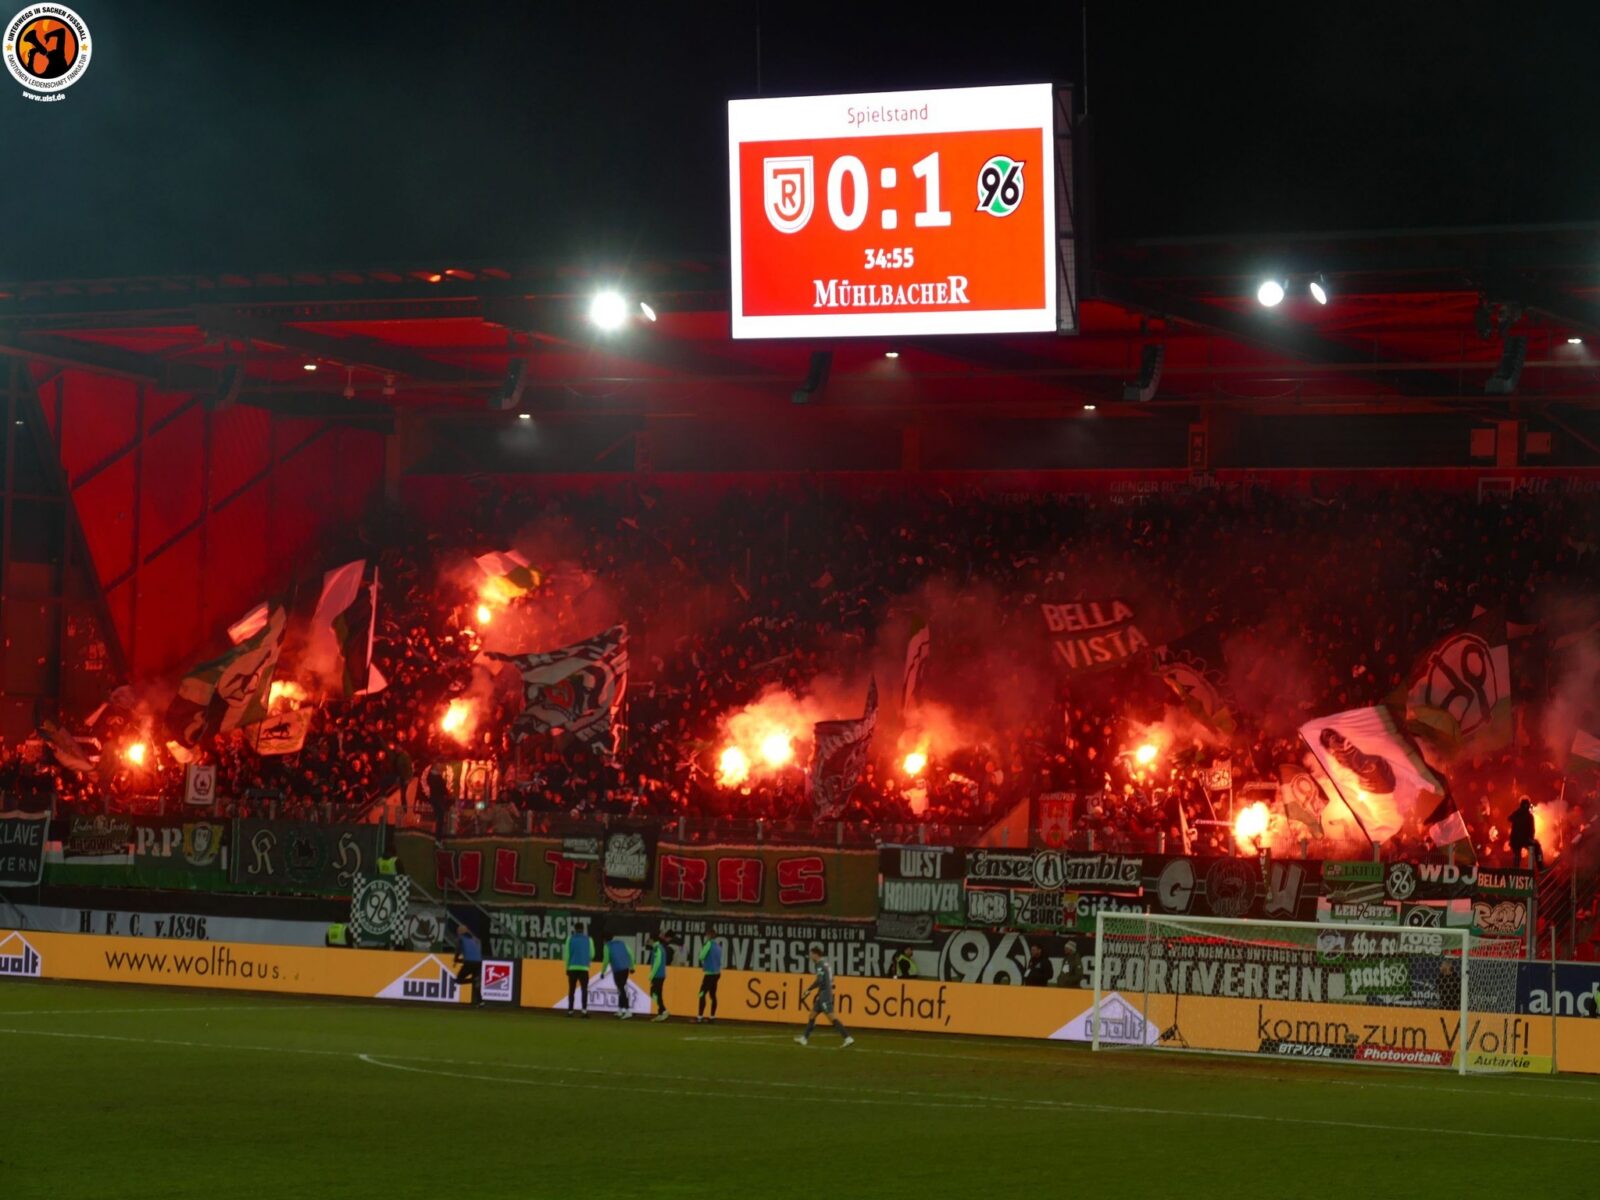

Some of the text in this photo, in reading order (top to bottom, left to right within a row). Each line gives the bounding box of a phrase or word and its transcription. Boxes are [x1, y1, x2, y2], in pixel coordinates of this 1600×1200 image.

[848, 104, 928, 127] Spielstand
[981, 166, 1020, 207] 96
[864, 247, 914, 269] 34:55
[813, 276, 970, 307] MÜHLBACHER
[1041, 601, 1134, 631] BELLA
[1055, 625, 1148, 668] VISTA
[901, 850, 943, 879] WEST
[1420, 864, 1478, 885] WDJ
[1393, 868, 1409, 893] 96
[1478, 872, 1533, 890] BELLA VISTA
[370, 893, 389, 922] 96
[1031, 907, 1064, 926] BURG
[1076, 895, 1142, 916] Giften
[80, 910, 95, 934] H.
[106, 912, 119, 935] F.
[130, 914, 143, 937] C.
[489, 912, 592, 940] EINTRACHT
[765, 925, 783, 939] DAS
[787, 927, 816, 941] BLEIBT
[1401, 932, 1442, 946] rote
[949, 929, 1023, 985] 96
[403, 966, 458, 997] wolf
[1081, 955, 1322, 1001] SPORTVEREIN
[746, 978, 951, 1025] Sei kin Schaf,
[1258, 1004, 1530, 1055] komm zum Wolf!
[1363, 1047, 1443, 1064] Photovoltaik
[1474, 1055, 1531, 1069] Autarkie
